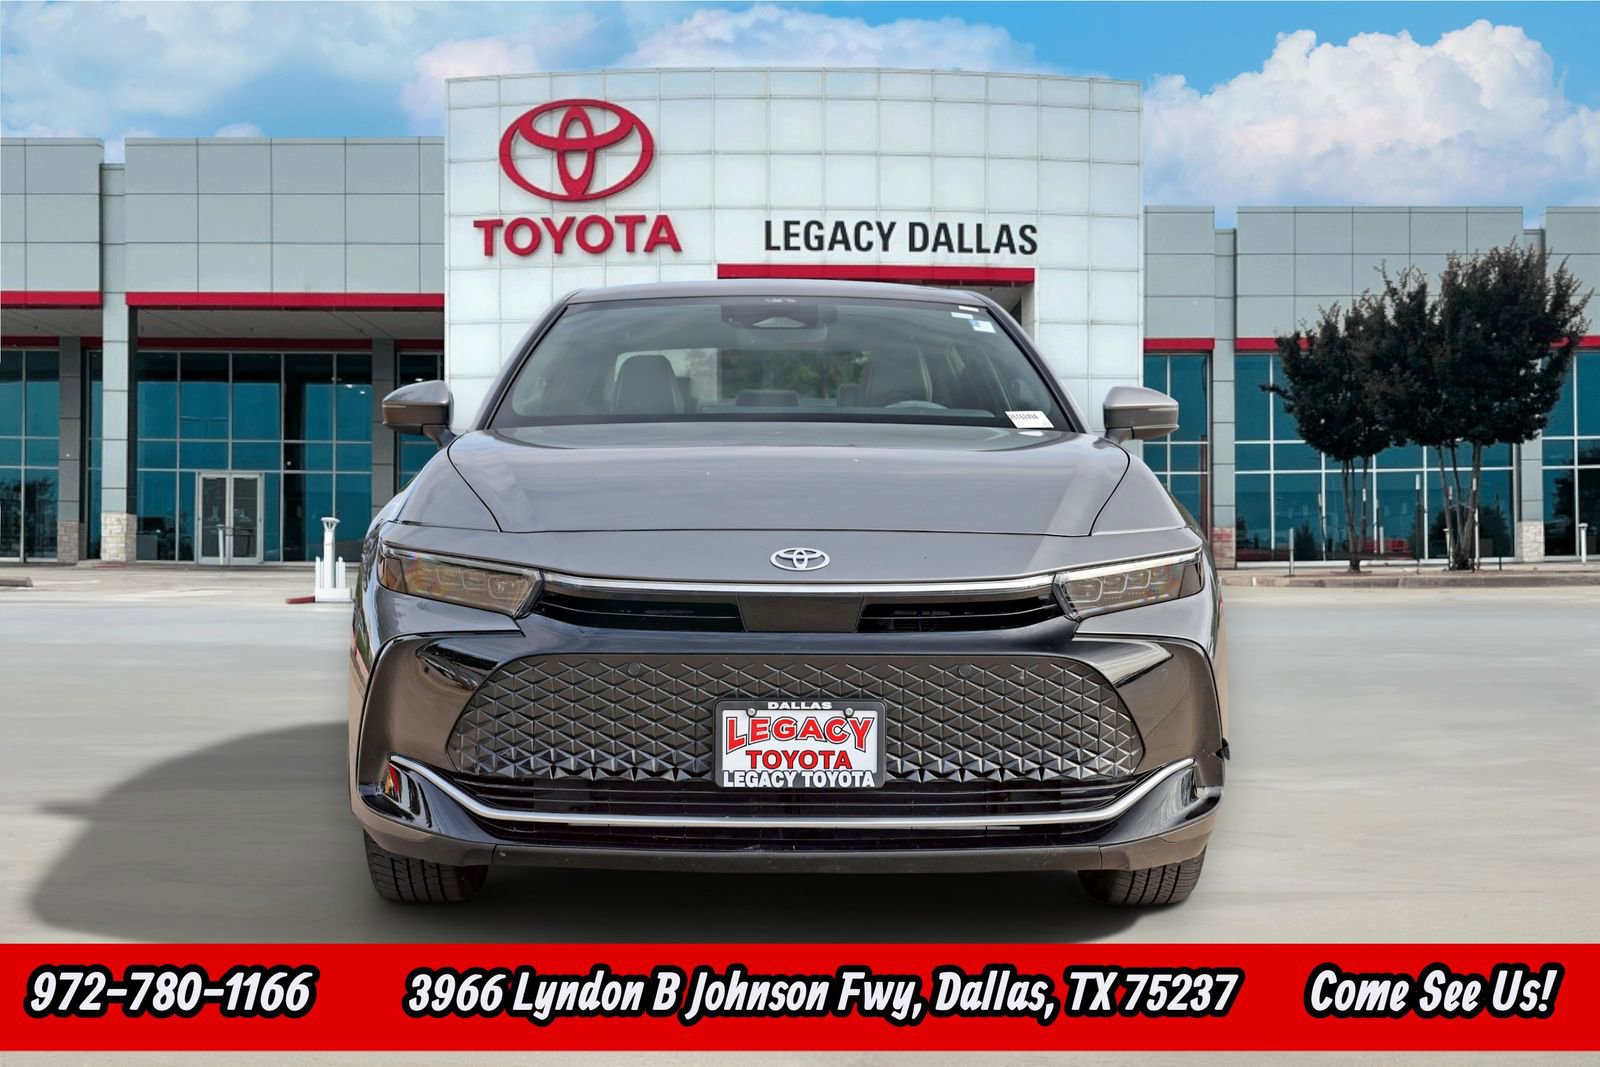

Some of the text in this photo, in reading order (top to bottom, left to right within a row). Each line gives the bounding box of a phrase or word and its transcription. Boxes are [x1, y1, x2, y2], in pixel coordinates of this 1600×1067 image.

[473, 214, 682, 257] TOYOTA
[764, 220, 1039, 256] LEGACY DALLAS
[767, 701, 833, 710] DALLAS
[725, 716, 875, 755] LEGACY
[745, 750, 852, 770] TOYOTA
[723, 770, 875, 788] LEGACY TOYOTA
